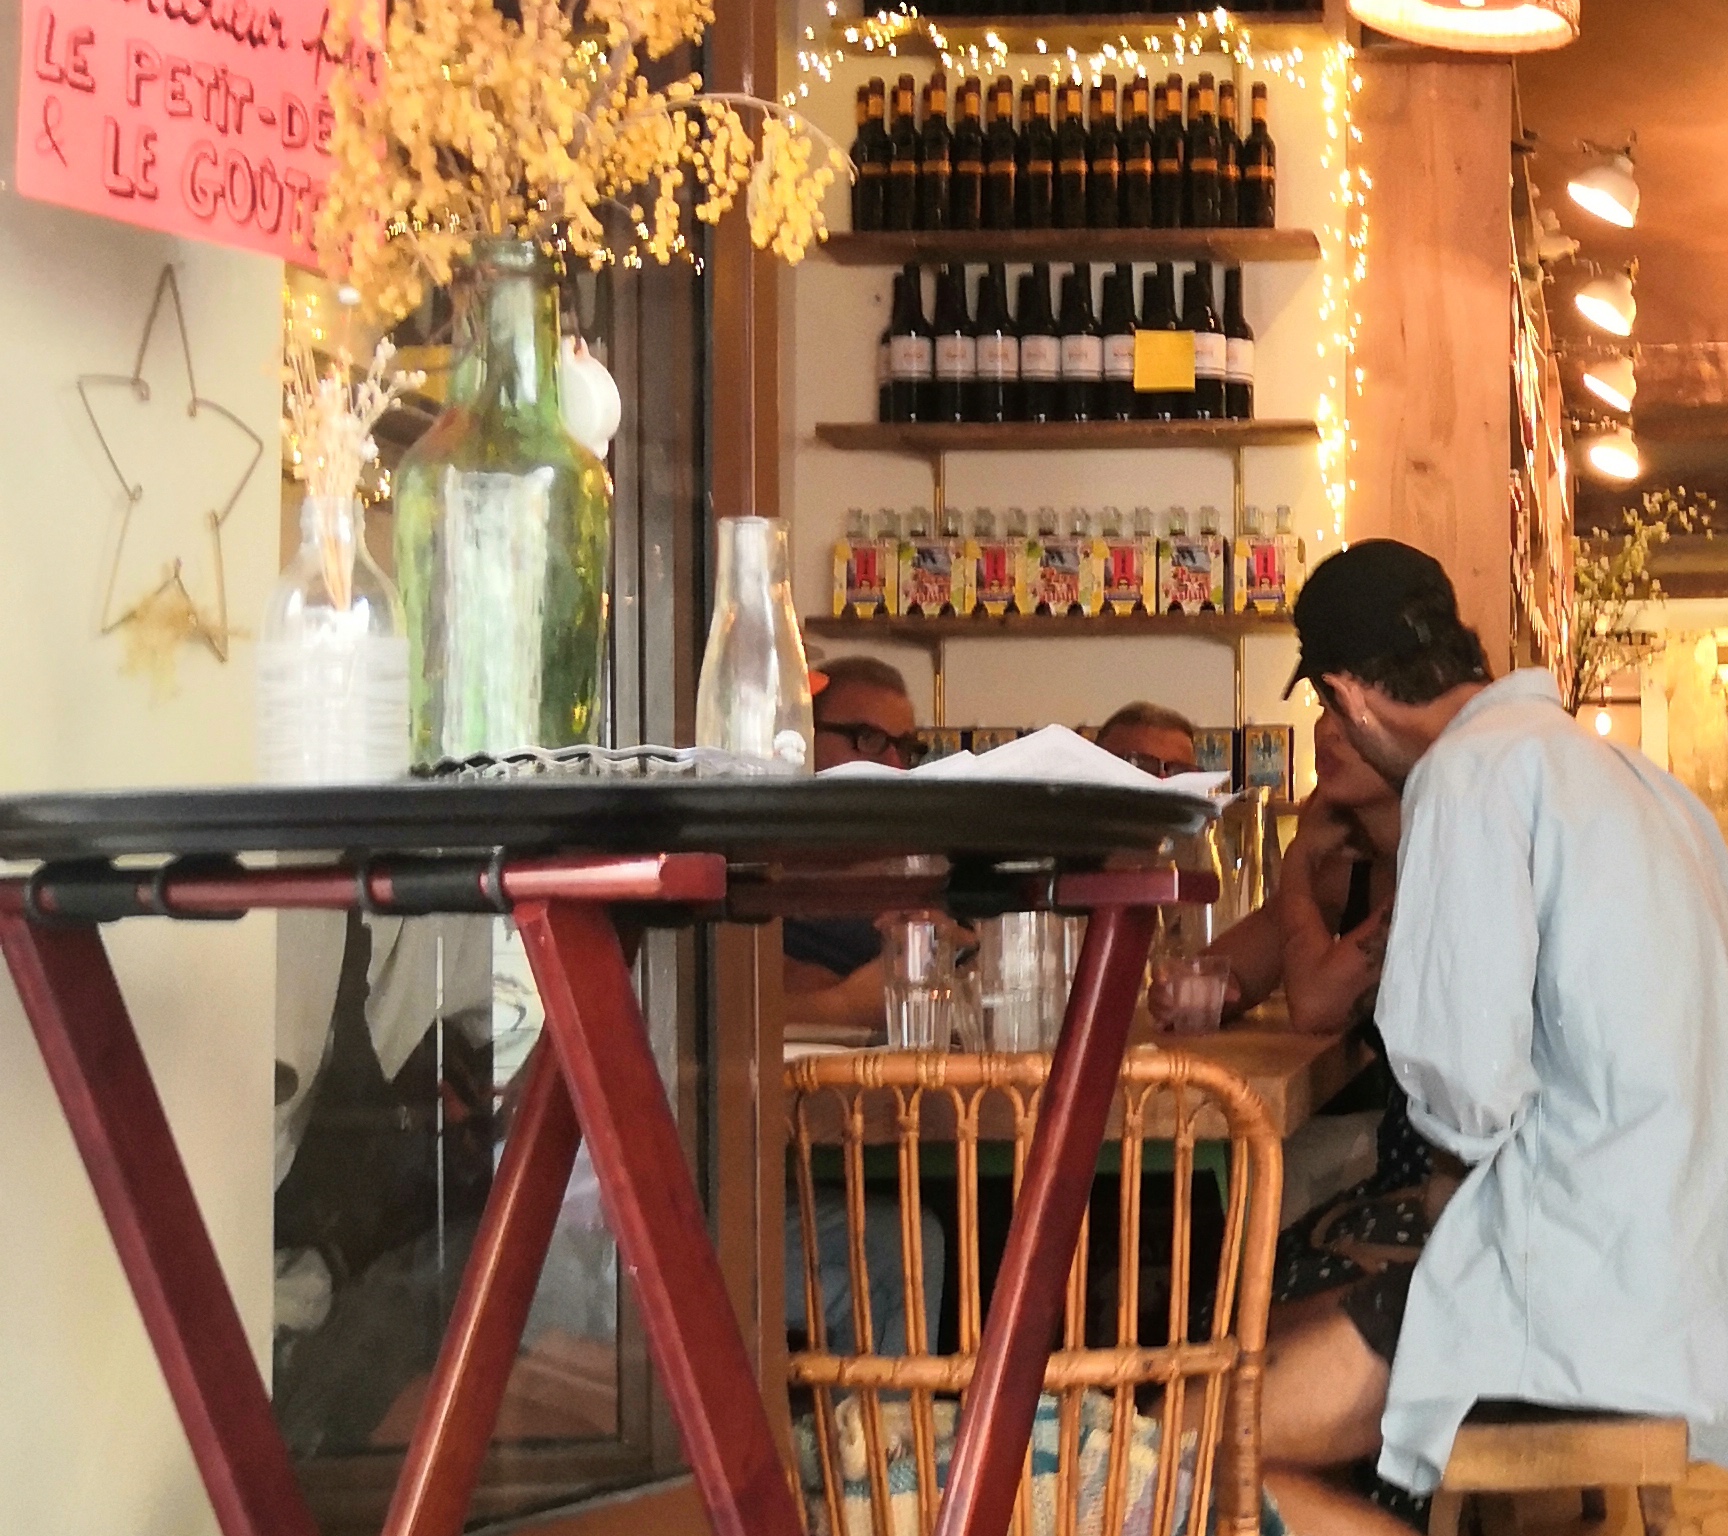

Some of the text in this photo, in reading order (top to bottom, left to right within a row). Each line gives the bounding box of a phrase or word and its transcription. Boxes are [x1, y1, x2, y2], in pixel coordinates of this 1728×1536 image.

[34, 6, 338, 156] LE PETIT-DÉ
[35, 94, 328, 254] & LE GOÛT
